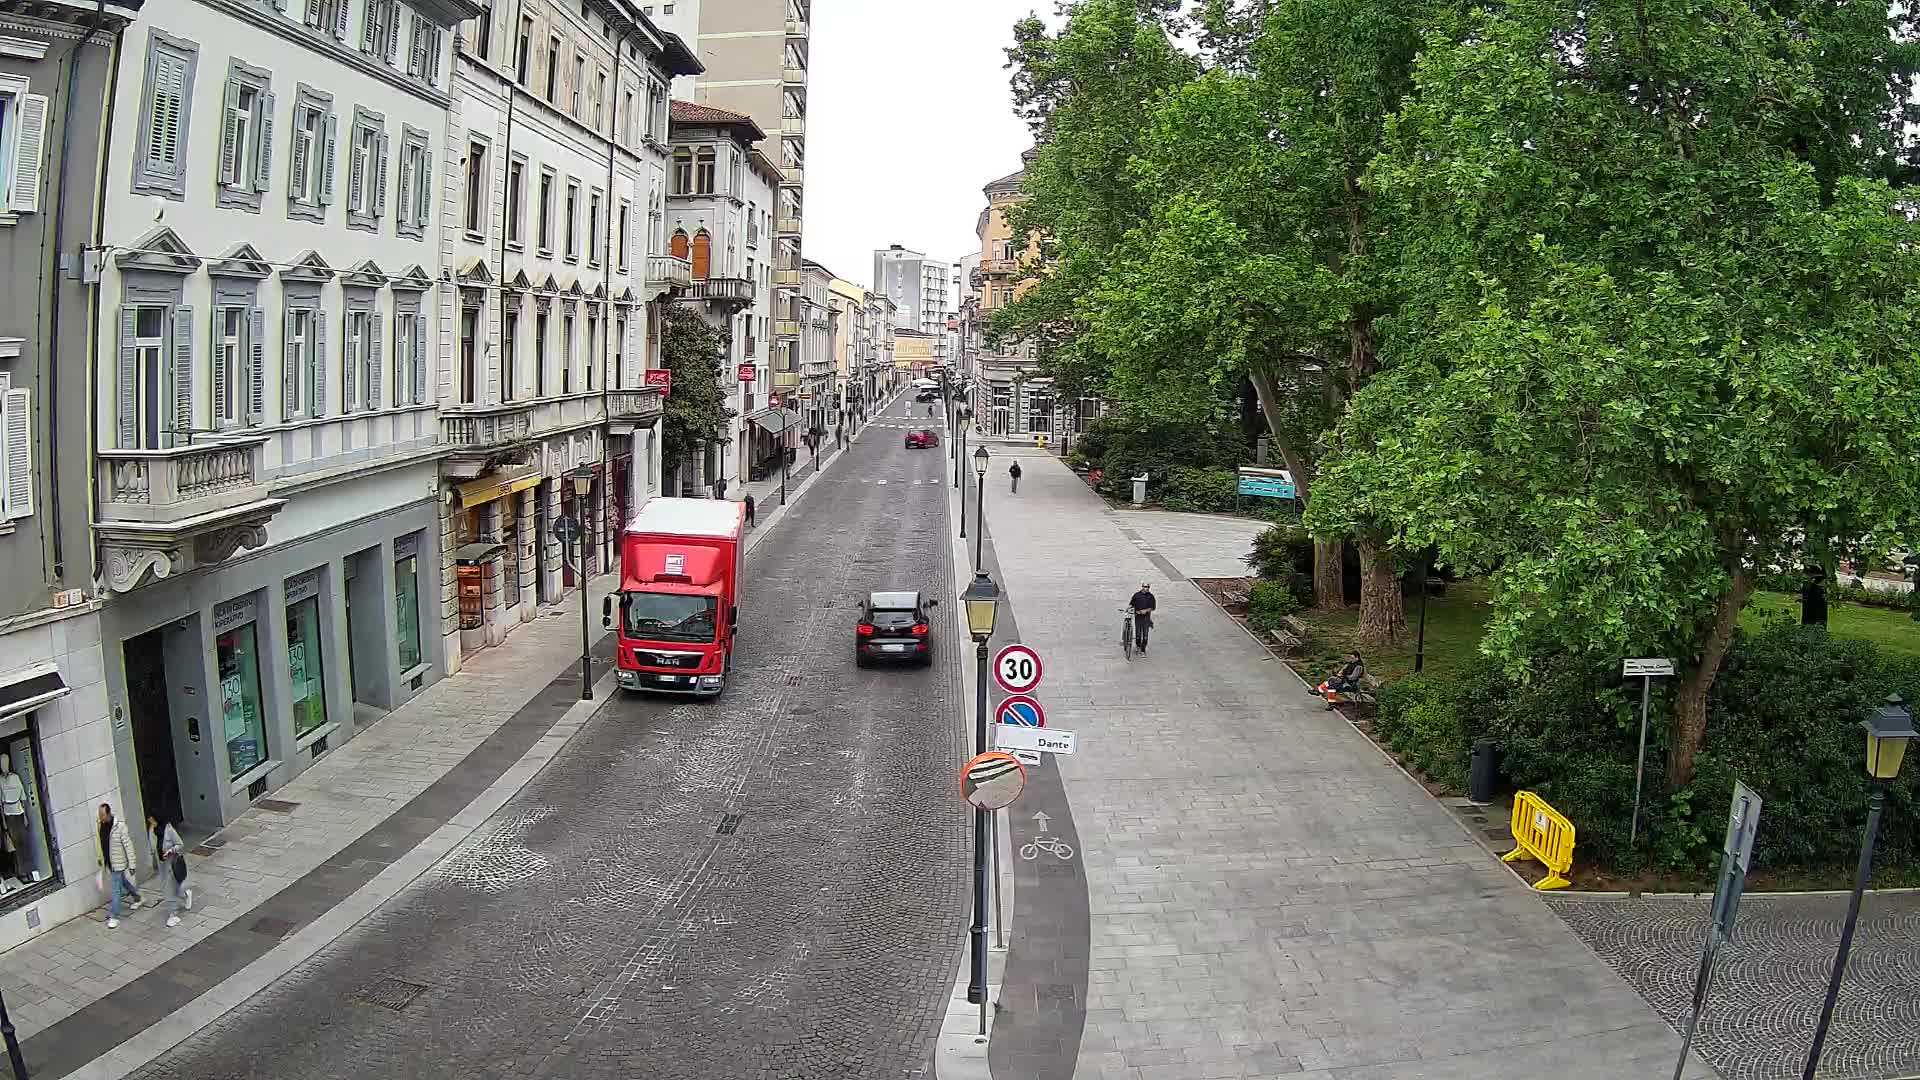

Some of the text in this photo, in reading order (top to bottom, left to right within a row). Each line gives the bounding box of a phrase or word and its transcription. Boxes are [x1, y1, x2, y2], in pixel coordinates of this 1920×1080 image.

[656, 657, 680, 666] MAN
[1005, 658, 1033, 680] 30
[222, 678, 240, 699] 130
[1038, 738, 1069, 749] Dante
